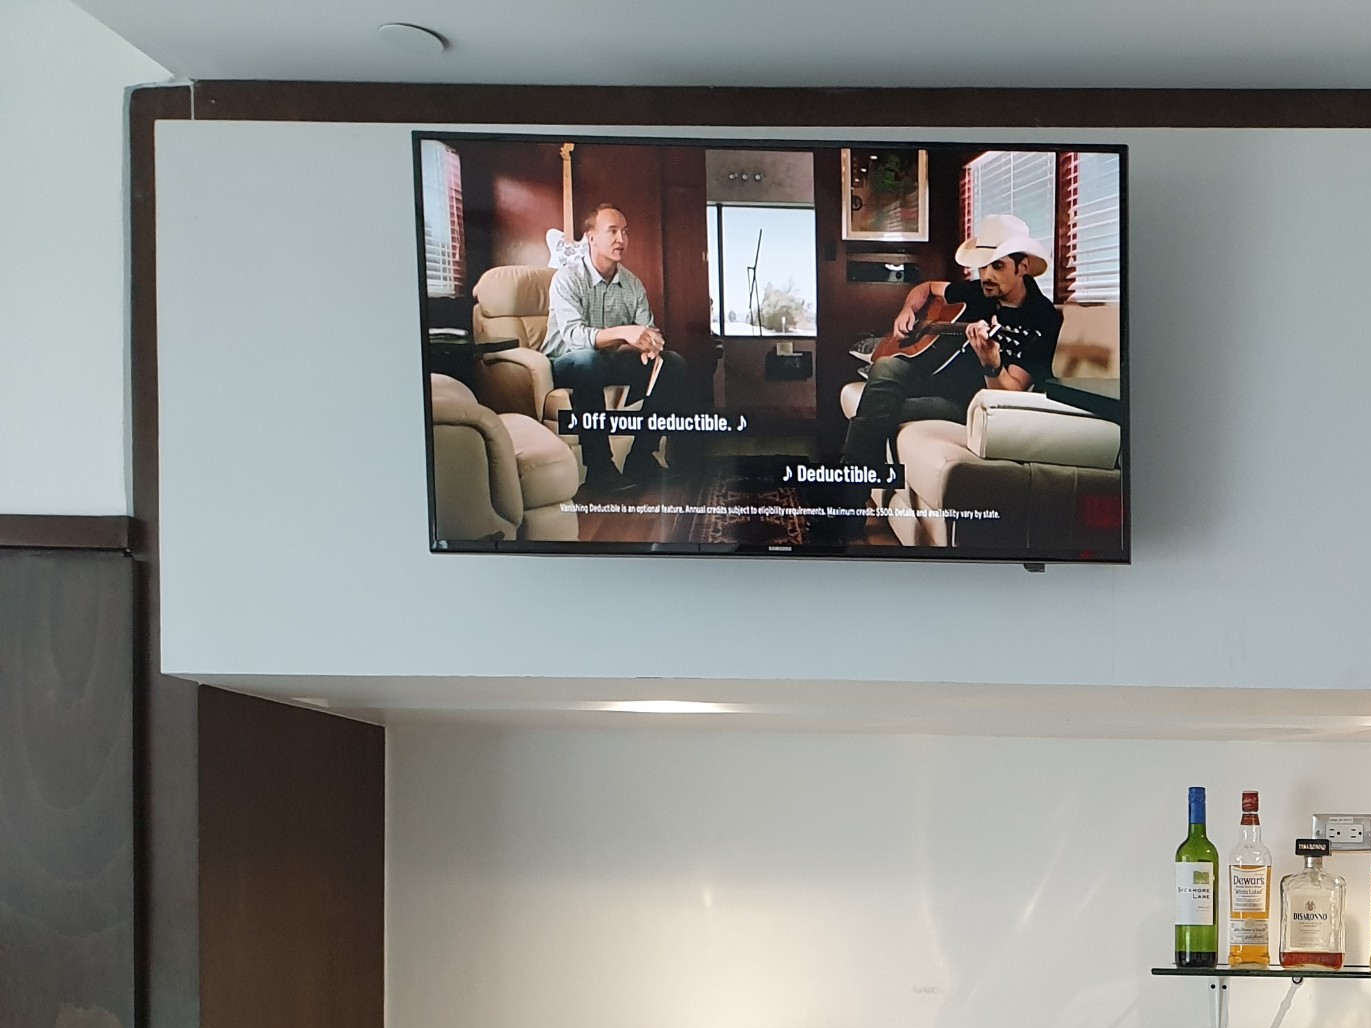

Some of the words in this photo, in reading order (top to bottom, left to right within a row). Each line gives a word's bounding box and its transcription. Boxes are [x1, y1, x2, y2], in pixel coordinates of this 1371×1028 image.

[582, 412, 606, 430] Off
[610, 415, 643, 433] your
[648, 414, 732, 431] deductible.
[797, 465, 881, 483] Deductible.
[560, 504, 588, 514] Vanishing
[589, 504, 620, 513] Deductible
[628, 505, 636, 513] an
[685, 505, 706, 514] Annual
[728, 506, 750, 516] subject
[751, 506, 758, 514] to
[758, 506, 785, 516] eligibility
[960, 510, 974, 520] vary
[974, 510, 982, 519] by
[1233, 876, 1265, 885] Dewar's
[1293, 912, 1328, 921] DISARONNO
